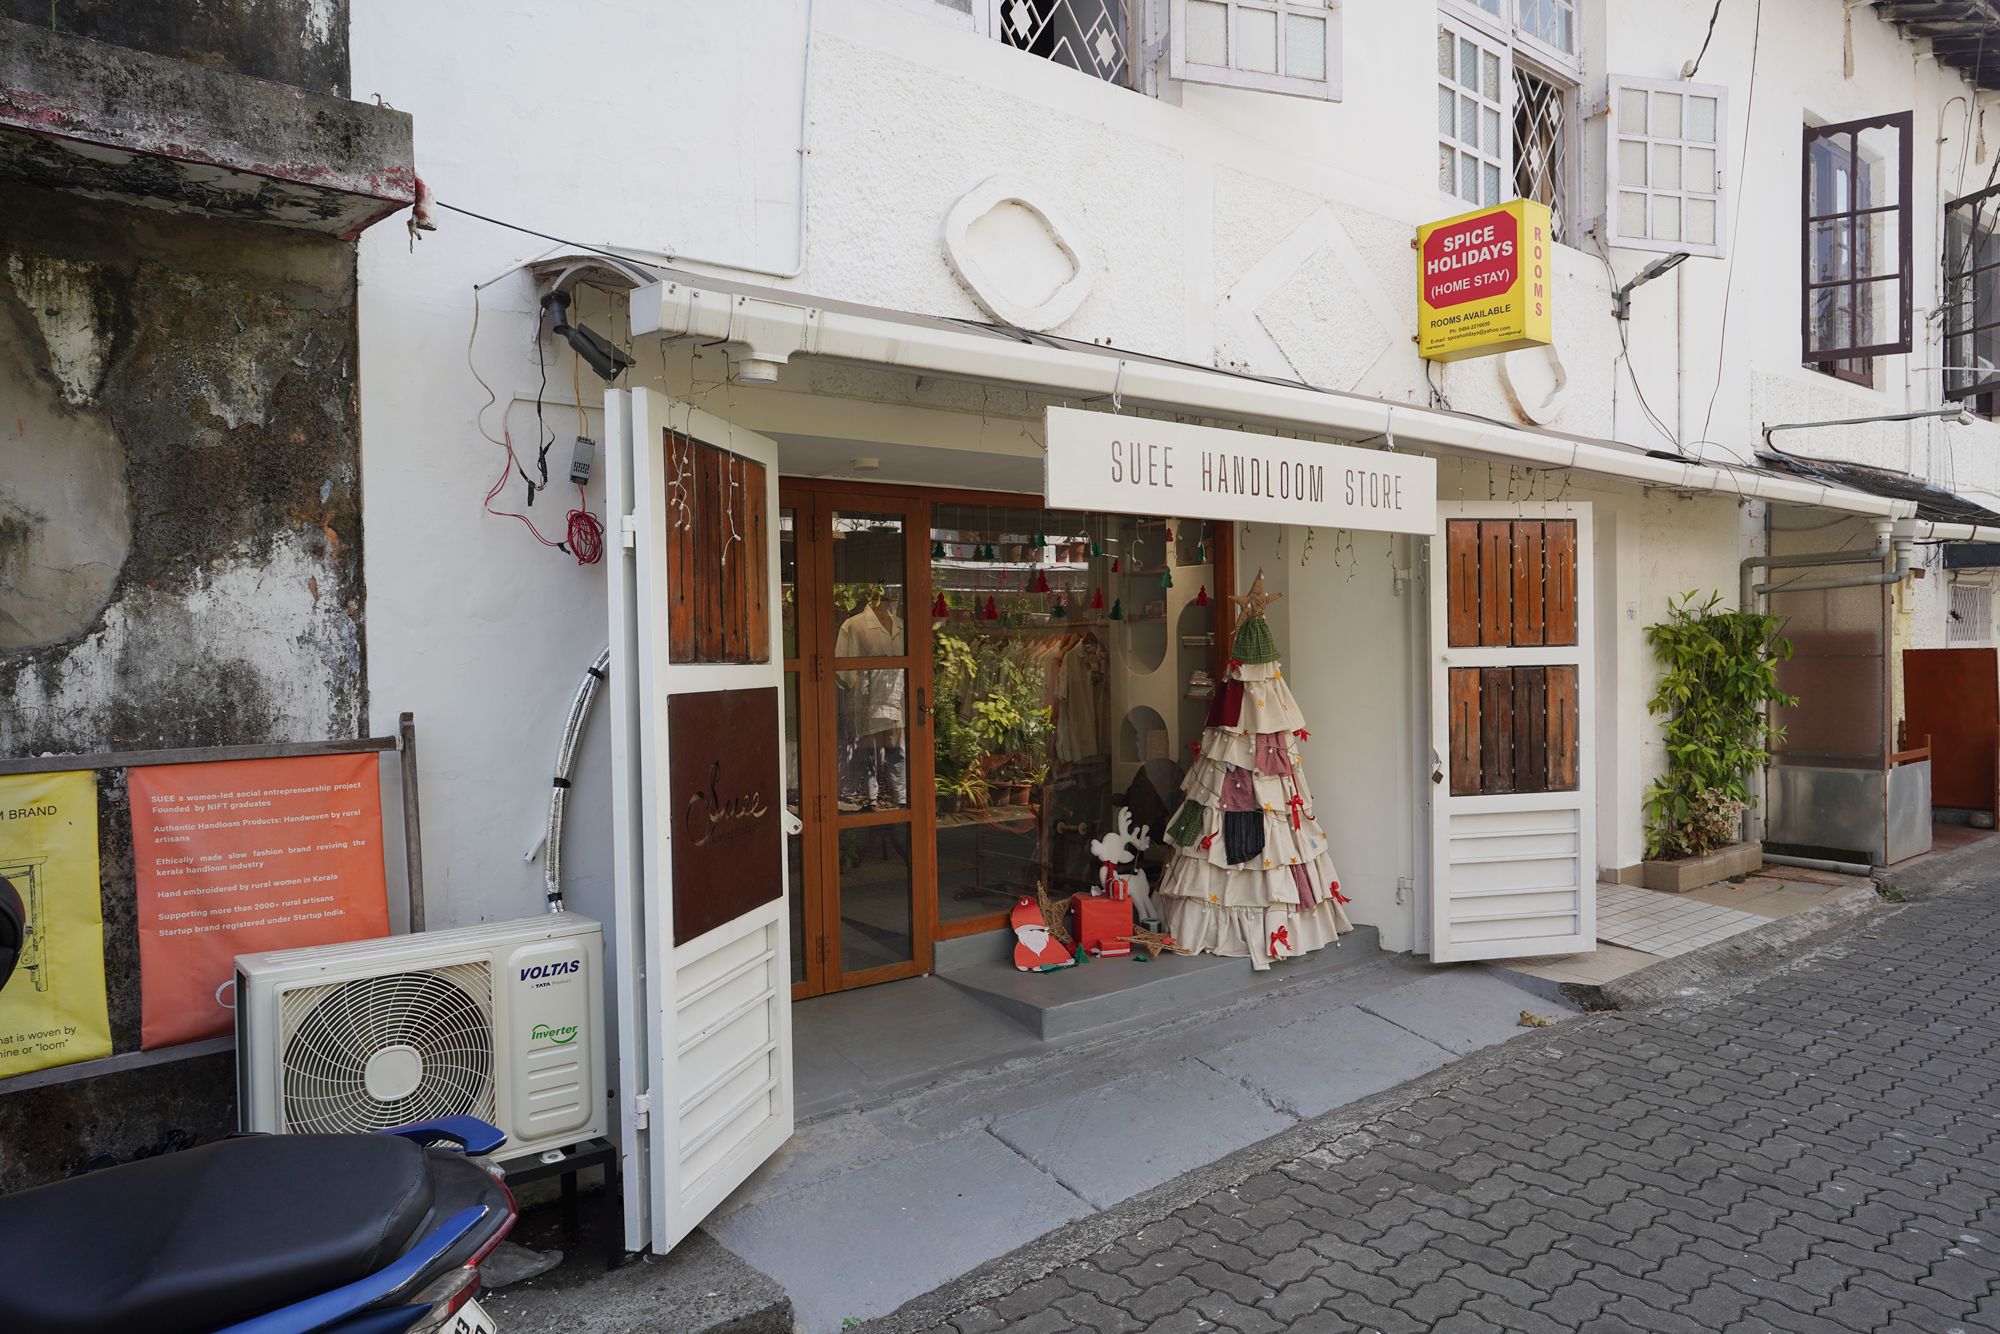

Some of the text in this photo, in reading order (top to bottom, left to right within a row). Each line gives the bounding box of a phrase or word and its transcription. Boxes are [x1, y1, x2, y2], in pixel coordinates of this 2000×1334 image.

[1443, 225, 1495, 253] SPICE
[1427, 240, 1513, 275] HOLIDAYS
[1534, 226, 1543, 317] ROOMS
[1431, 268, 1510, 299] (HOME STAY)
[1430, 304, 1511, 329] ROOMS AVAILABLE
[1111, 440, 1402, 510] SUEE HANDLOOM STORE
[151, 795, 176, 803] SUEE
[187, 792, 233, 801] women-led
[236, 790, 261, 798] social
[264, 785, 331, 795] entreprenuership
[334, 782, 361, 791] project
[9, 805, 57, 820] BRAND
[152, 800, 271, 813] Founded by NIFT graduates
[154, 809, 361, 832] Authentic Handloom Products: Handwoven by rural
[155, 835, 190, 843] artisans
[156, 856, 194, 865] Ethically
[228, 852, 247, 860] slow
[253, 848, 283, 857] fashion
[288, 845, 311, 854] brand
[317, 841, 348, 851] reviving
[156, 861, 264, 876] kerala handloom industry
[157, 890, 181, 898] Hand
[183, 884, 237, 896] embroidered
[239, 883, 249, 891] by
[251, 881, 271, 889] rural
[273, 878, 302, 886] women
[313, 874, 338, 882] Kerala
[158, 909, 208, 921] Supporting
[234, 905, 252, 913] than
[254, 902, 279, 910] 2000+
[282, 898, 301, 907] rural
[302, 895, 334, 905] artisans
[159, 908, 346, 937] Startup brand registered under Startup India.
[520, 960, 580, 981] VOLTAS
[16, 1033, 25, 1042] is
[27, 1028, 61, 1040] woven
[64, 1026, 77, 1035] by
[531, 1025, 578, 1040] Inverter
[22, 1046, 33, 1055] or
